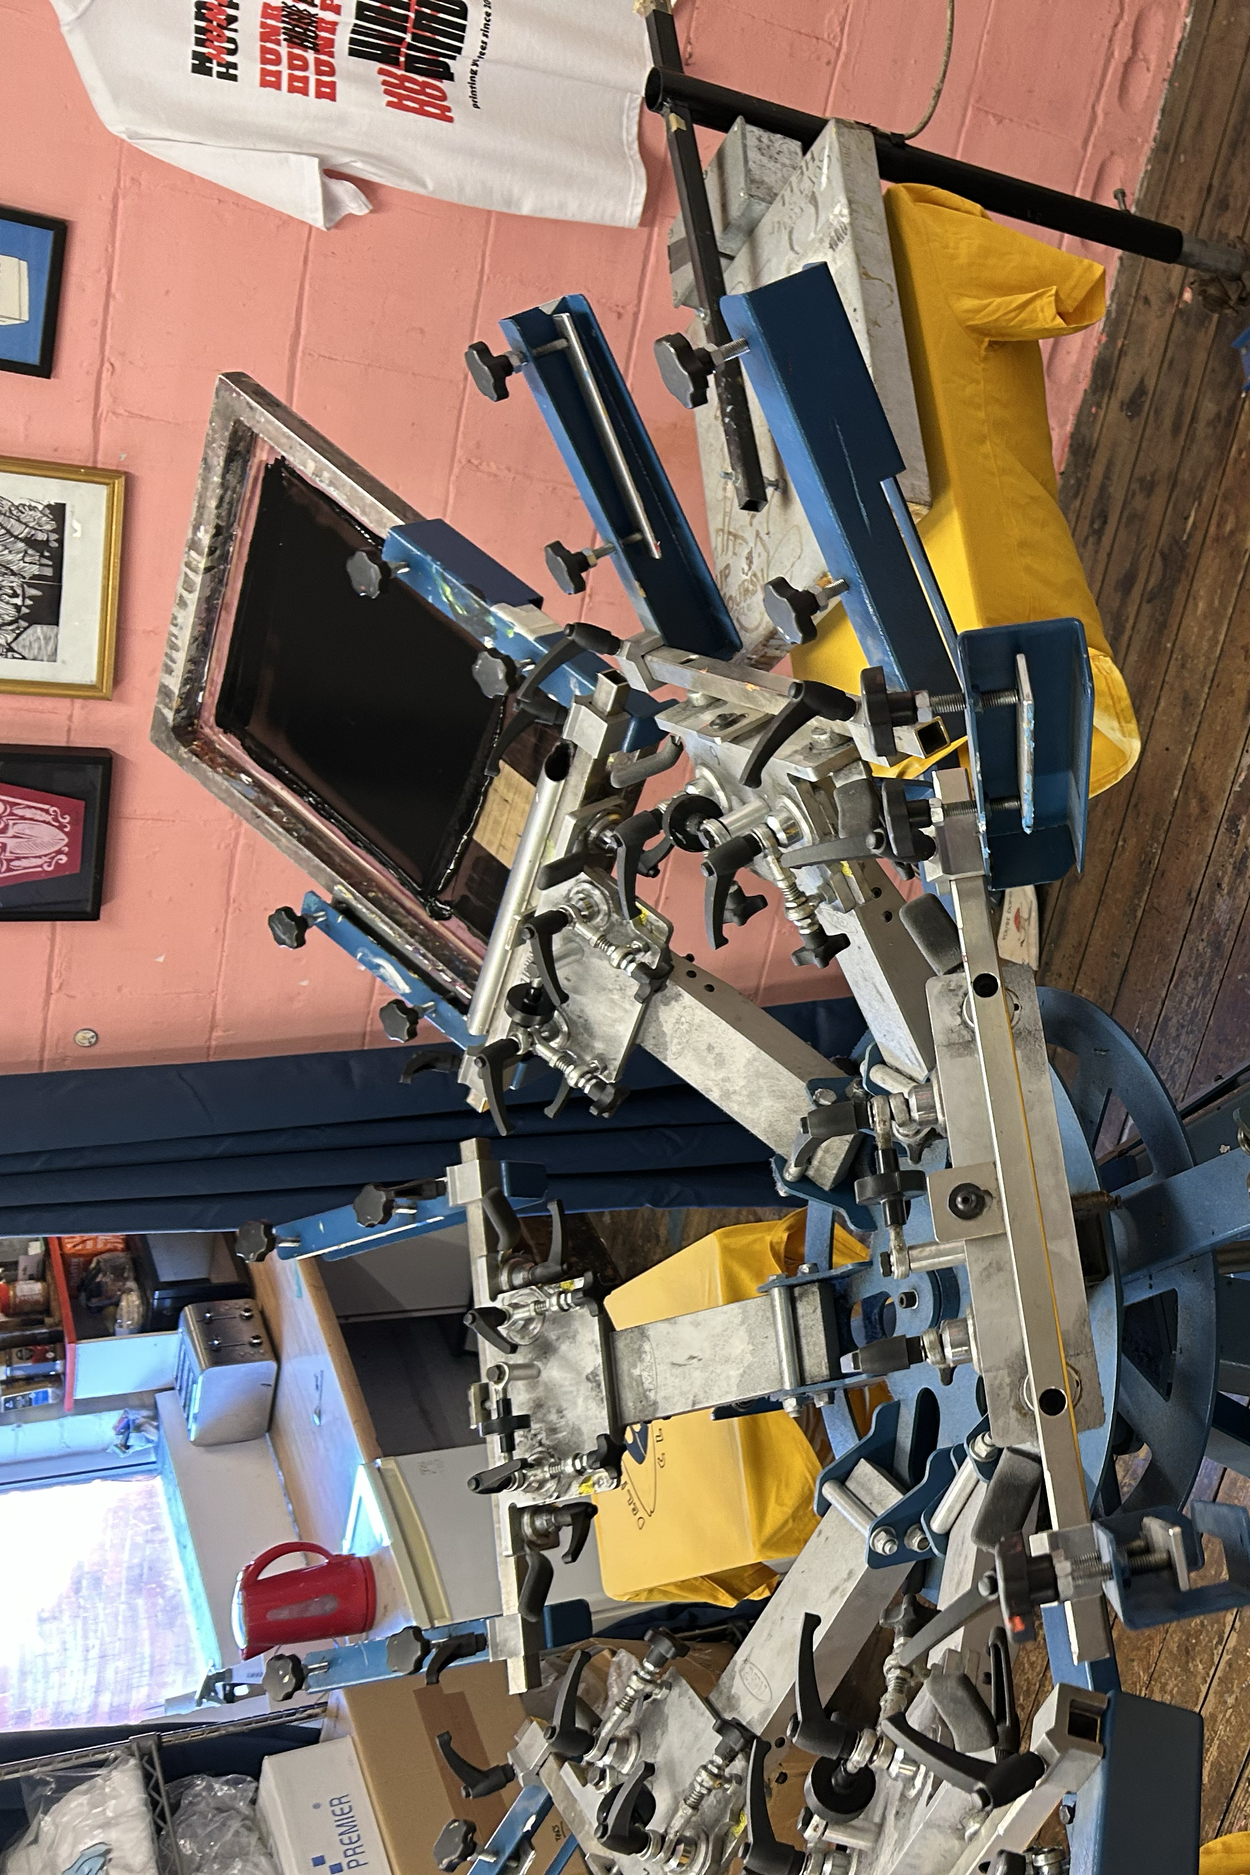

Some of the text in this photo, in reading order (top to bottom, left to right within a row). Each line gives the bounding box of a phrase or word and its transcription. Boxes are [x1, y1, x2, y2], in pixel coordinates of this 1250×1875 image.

[467, 67, 480, 110] printing
[480, 10, 492, 39] since
[329, 1793, 369, 1870] PREMIER
